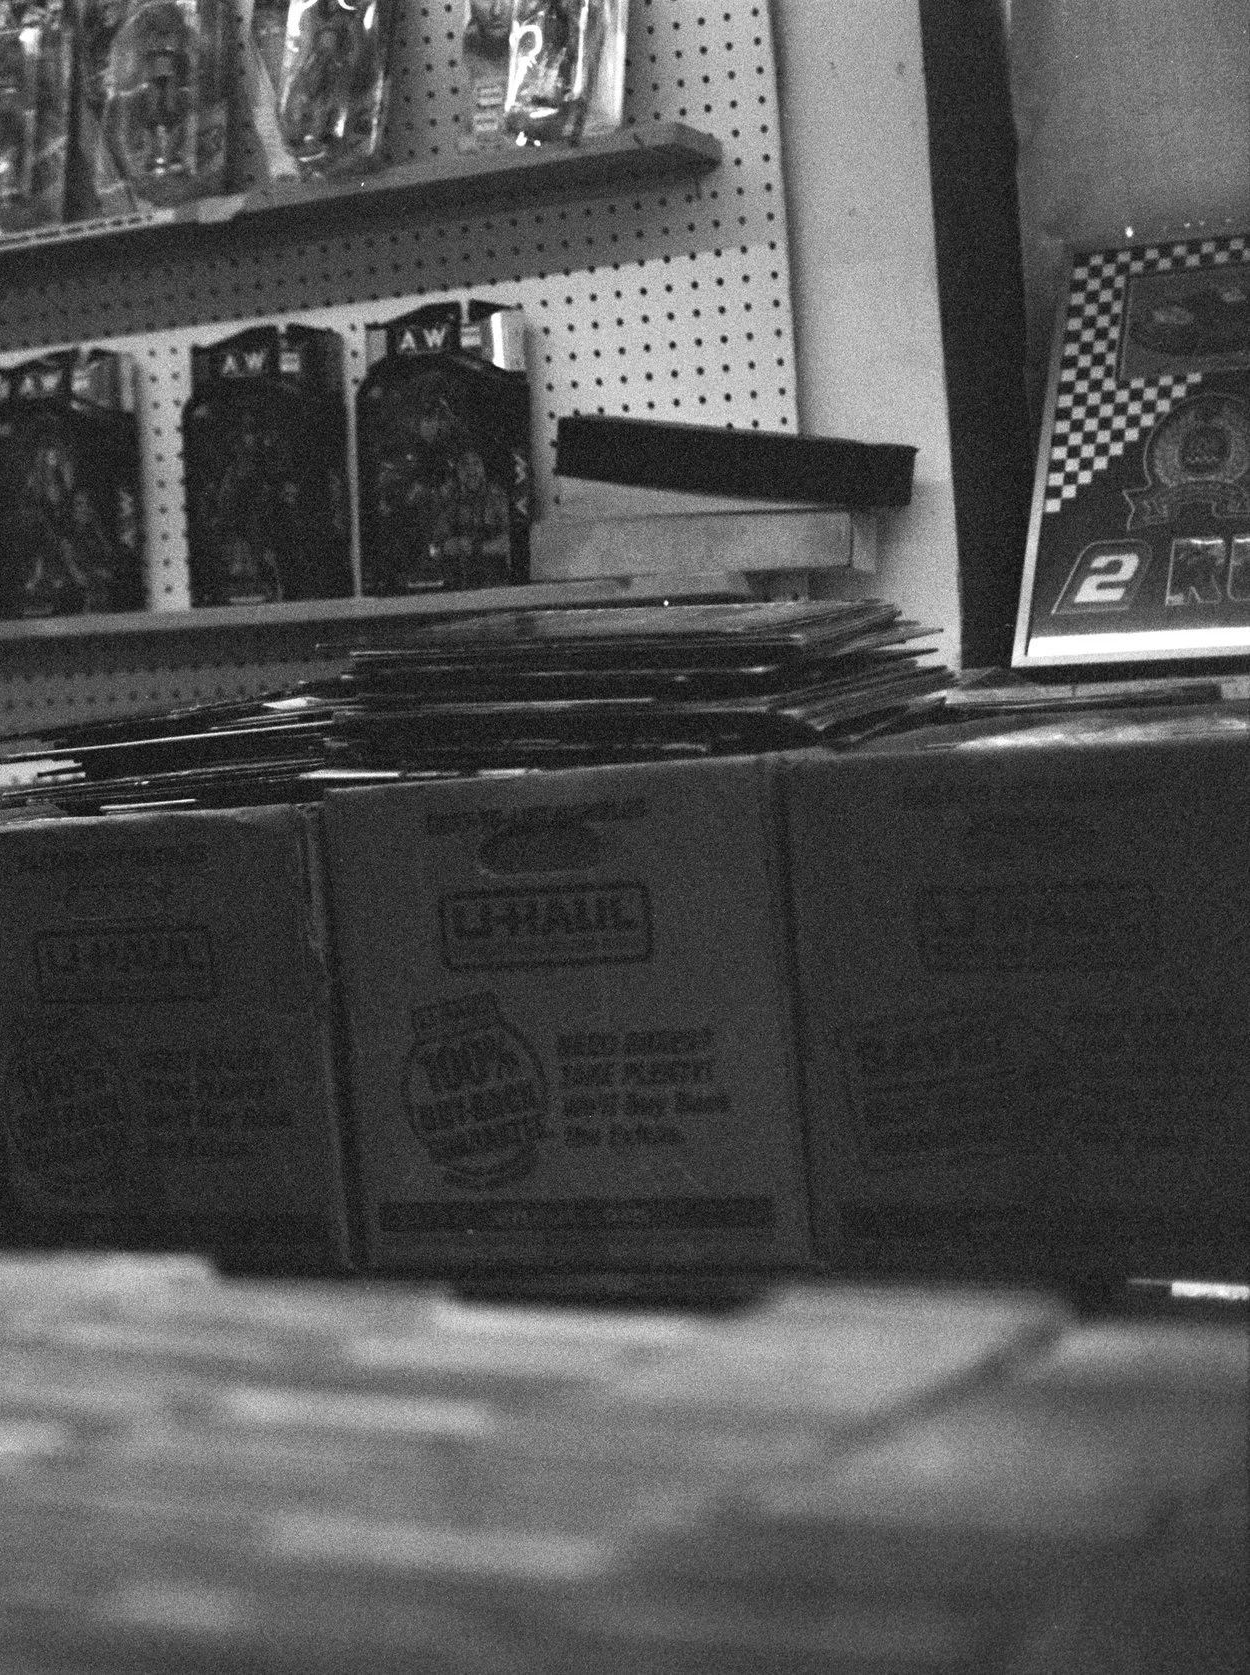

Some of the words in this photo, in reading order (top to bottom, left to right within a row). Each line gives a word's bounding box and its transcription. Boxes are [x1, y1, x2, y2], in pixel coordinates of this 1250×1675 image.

[1073, 551, 1140, 605] 2
[452, 896, 639, 938] U-HAUL
[43, 932, 206, 974] U-HAUL
